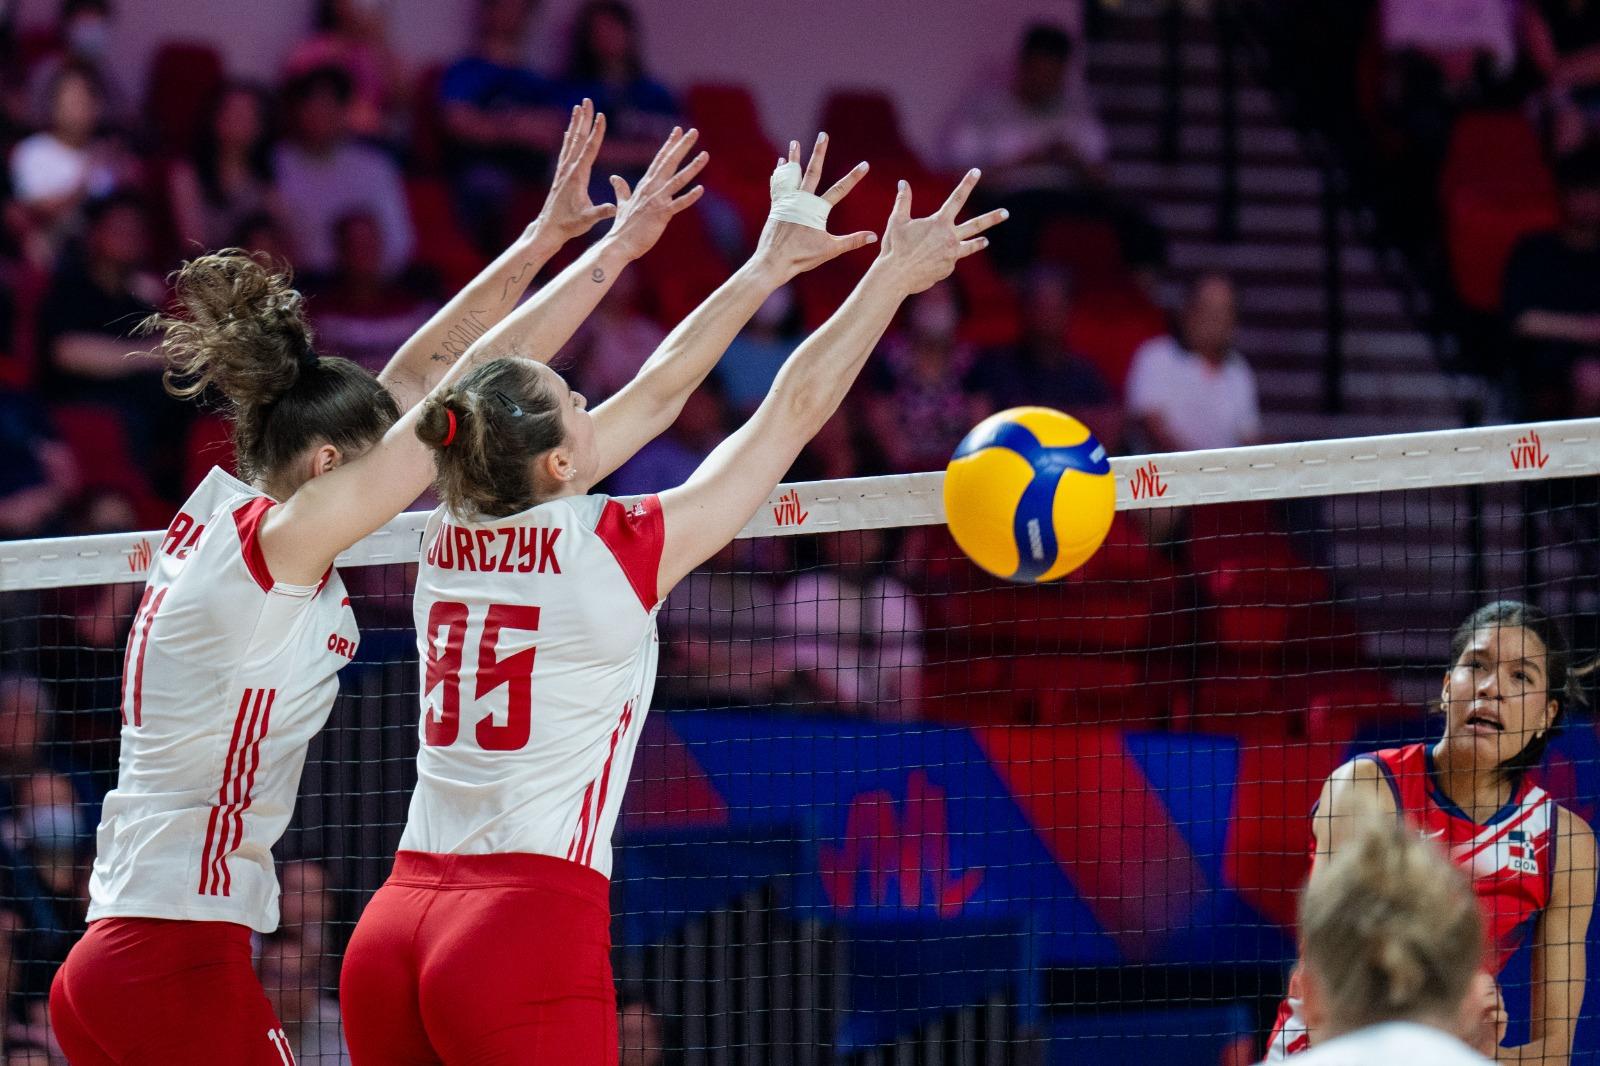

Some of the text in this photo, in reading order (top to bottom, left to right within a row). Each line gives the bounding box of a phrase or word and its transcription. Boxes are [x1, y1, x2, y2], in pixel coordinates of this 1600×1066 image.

[1511, 430, 1549, 469] VNL
[1130, 460, 1168, 499] VNL
[774, 488, 808, 526] VNL
[427, 525, 562, 574] JURCZYK
[424, 601, 541, 751] 95
[819, 769, 985, 919] VNL
